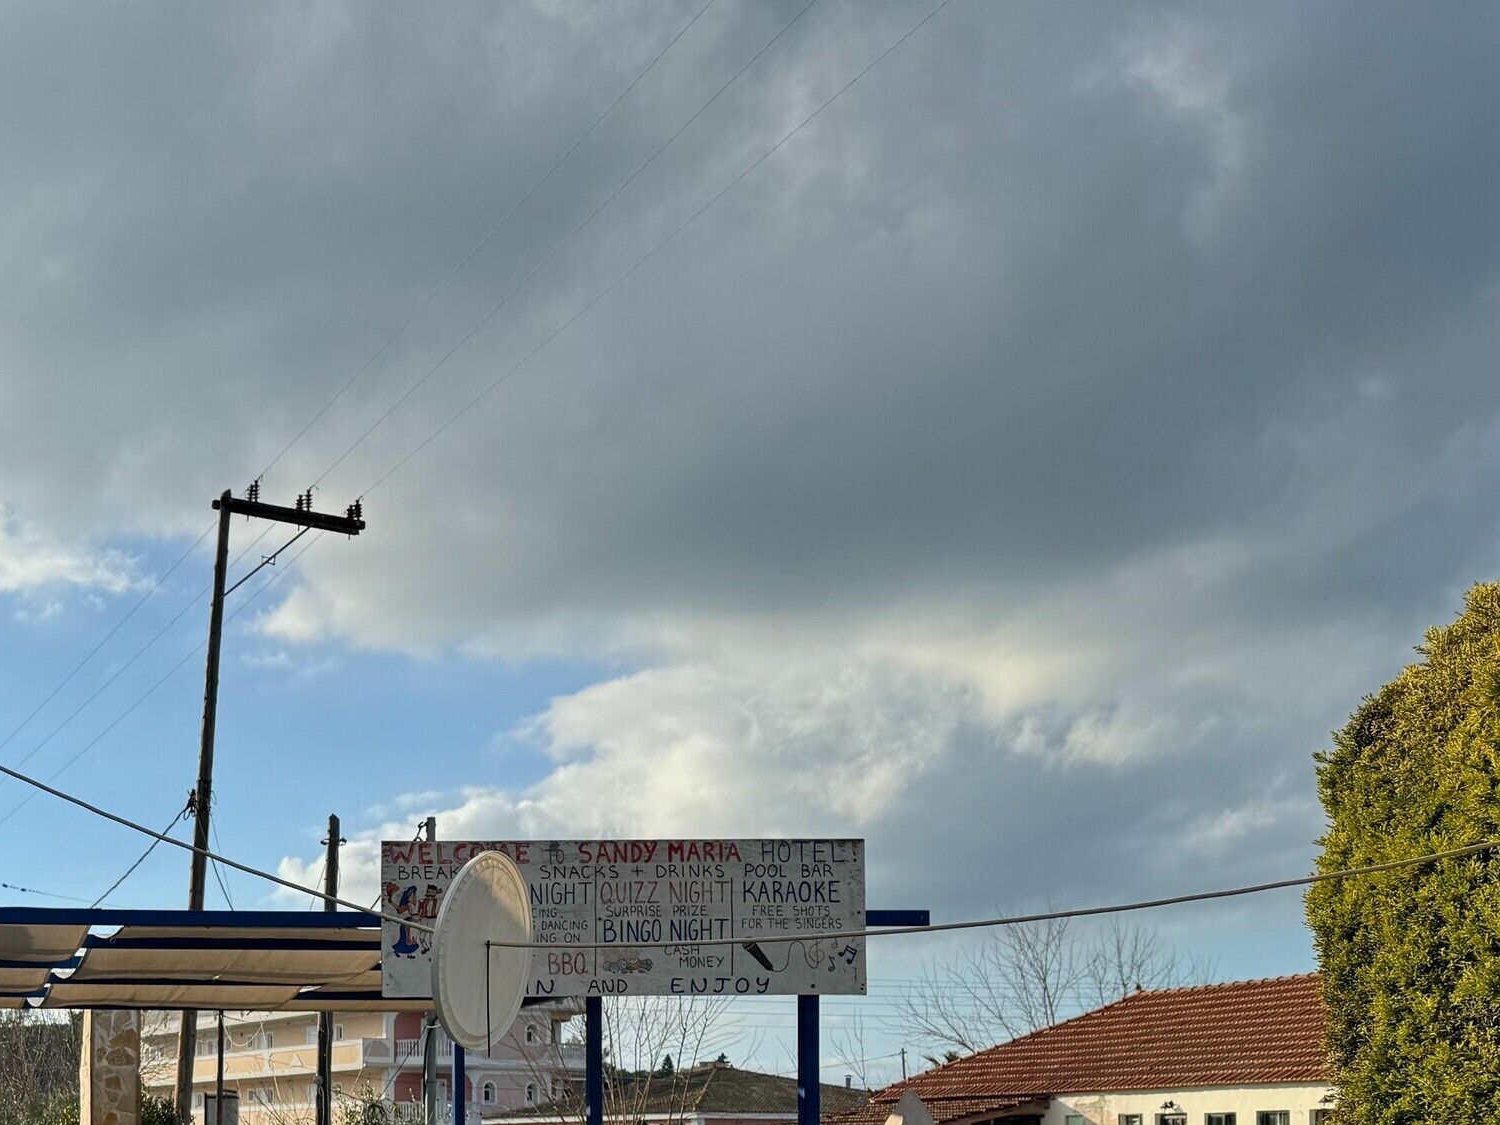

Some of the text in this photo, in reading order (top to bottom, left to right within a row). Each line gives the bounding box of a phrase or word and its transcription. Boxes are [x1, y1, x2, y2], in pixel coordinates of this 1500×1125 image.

[548, 848, 565, 864] TO
[578, 842, 657, 865] SANDY
[668, 842, 742, 863] MARIA
[398, 863, 833, 880] BREAK SNACKS + DRINKS POOL BAR
[531, 882, 593, 905] NIGHT
[600, 881, 729, 905] QUIZZ NIGHT
[743, 880, 840, 903] KARAOKE
[606, 906, 708, 917] SURPRISE PRIZE
[753, 905, 830, 917] FREE SHOTS
[603, 918, 729, 942] BINGO NIGHT
[742, 918, 842, 929] FOR THE SINGERS
[534, 933, 580, 943] ING ON
[664, 946, 700, 956] CASH
[548, 952, 588, 975] BBQ
[680, 956, 725, 967] MONEY
[588, 980, 628, 994] AND
[671, 977, 770, 994] ENJOY
